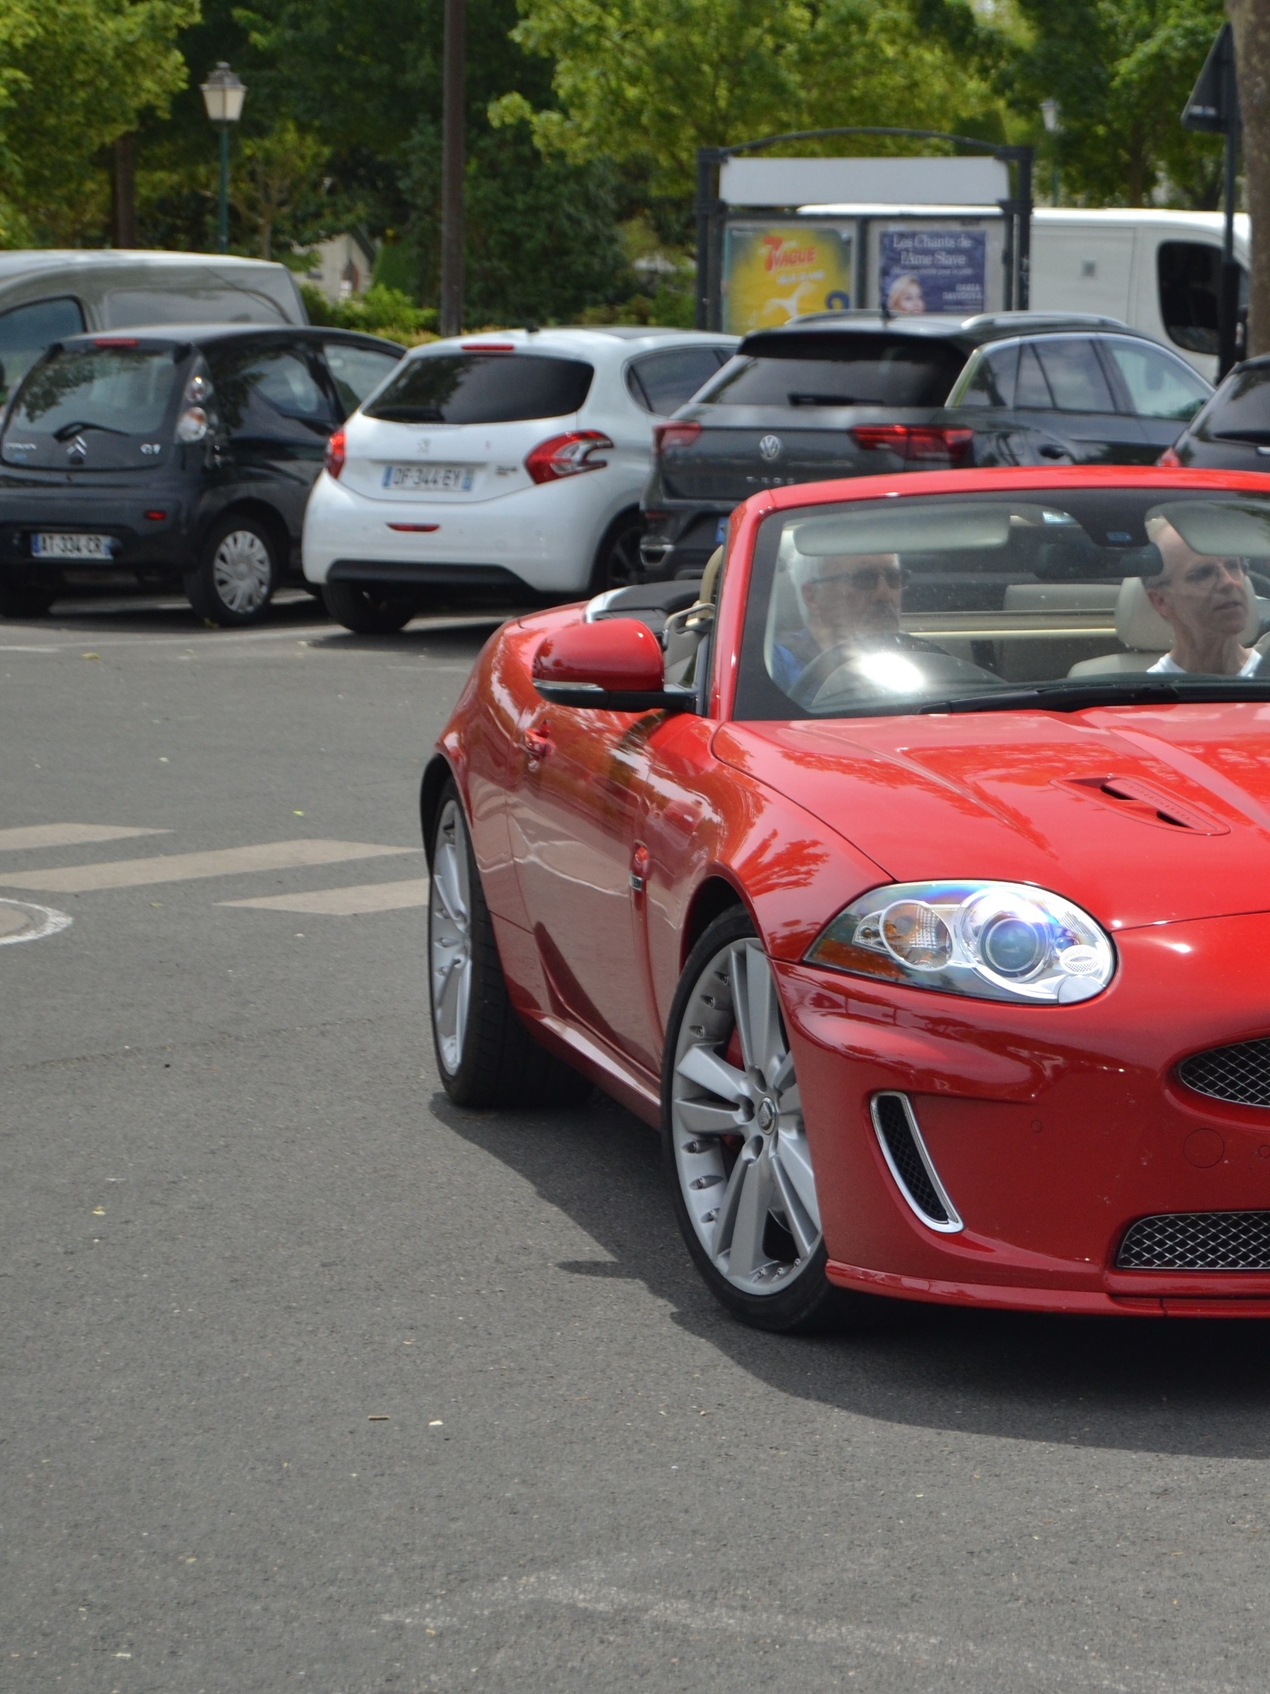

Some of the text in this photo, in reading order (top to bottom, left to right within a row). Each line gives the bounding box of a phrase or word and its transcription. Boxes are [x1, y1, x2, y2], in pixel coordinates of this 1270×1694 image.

[893, 234, 972, 248] Les Chants de
[934, 250, 966, 265] Slave
